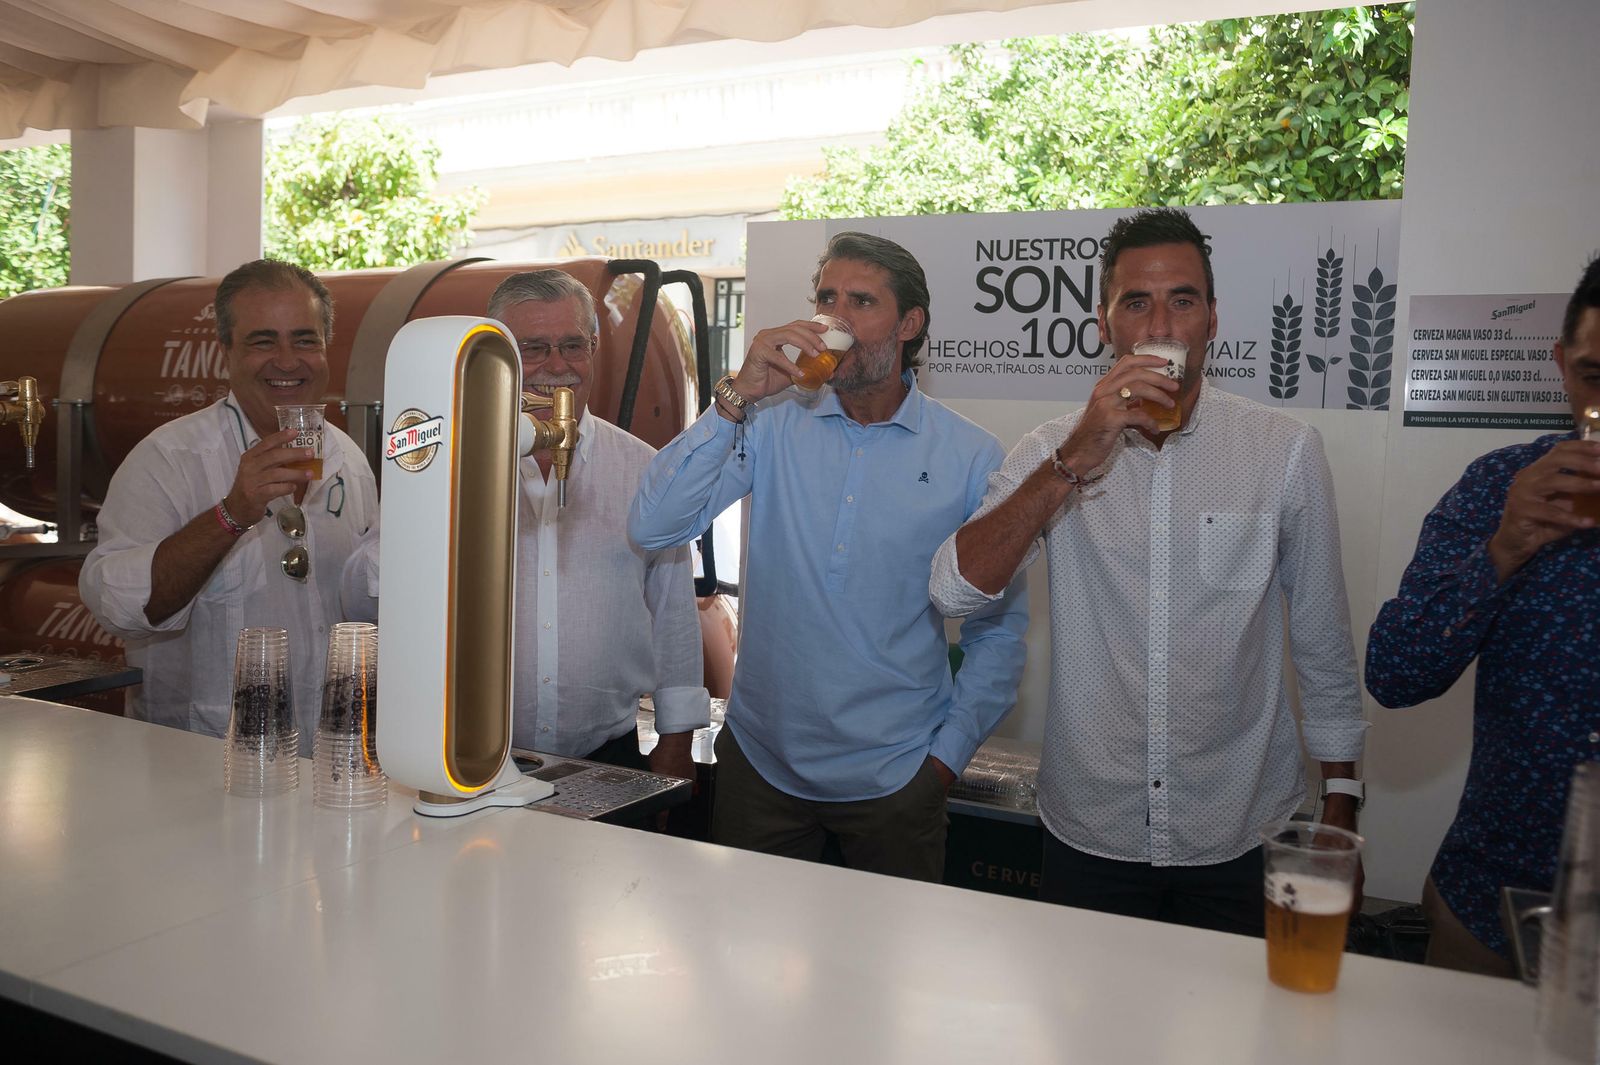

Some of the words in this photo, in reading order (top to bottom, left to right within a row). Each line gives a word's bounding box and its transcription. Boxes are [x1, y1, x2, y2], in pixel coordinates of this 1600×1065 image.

[592, 229, 716, 259] Santander
[973, 264, 1094, 314] SON
[928, 340, 1020, 359] HECHOS
[1021, 317, 1116, 359] 100
[1413, 329, 1444, 341] CERVEZA
[1446, 329, 1472, 341] MAGNA
[1473, 329, 1493, 341] VASO
[1494, 329, 1503, 340] 33
[1412, 349, 1443, 361] CERVEZA
[1445, 349, 1460, 361] SAN
[1461, 349, 1489, 361] MIGUEL
[1490, 349, 1526, 361] ESPECIAL
[1527, 349, 1548, 361] VASO
[928, 362, 953, 373] POR
[1047, 364, 1063, 375] AL
[1200, 364, 1256, 379] ÁNICOS
[1411, 369, 1442, 381] CERVEZA
[1443, 369, 1458, 381] SAN
[1460, 369, 1487, 381] MIGUEL
[1488, 370, 1501, 384] 0,0
[1501, 370, 1521, 382] VASO
[1522, 370, 1532, 382] 33
[1410, 389, 1441, 401] CERVEZA
[1442, 389, 1457, 401] SAN
[1458, 389, 1485, 401] MIGUEL
[1486, 390, 1500, 402] SIN
[1500, 390, 1531, 402] GLUTEN
[1531, 391, 1552, 402] VASO
[1552, 391, 1562, 403] 33
[296, 437, 314, 446] BIO
